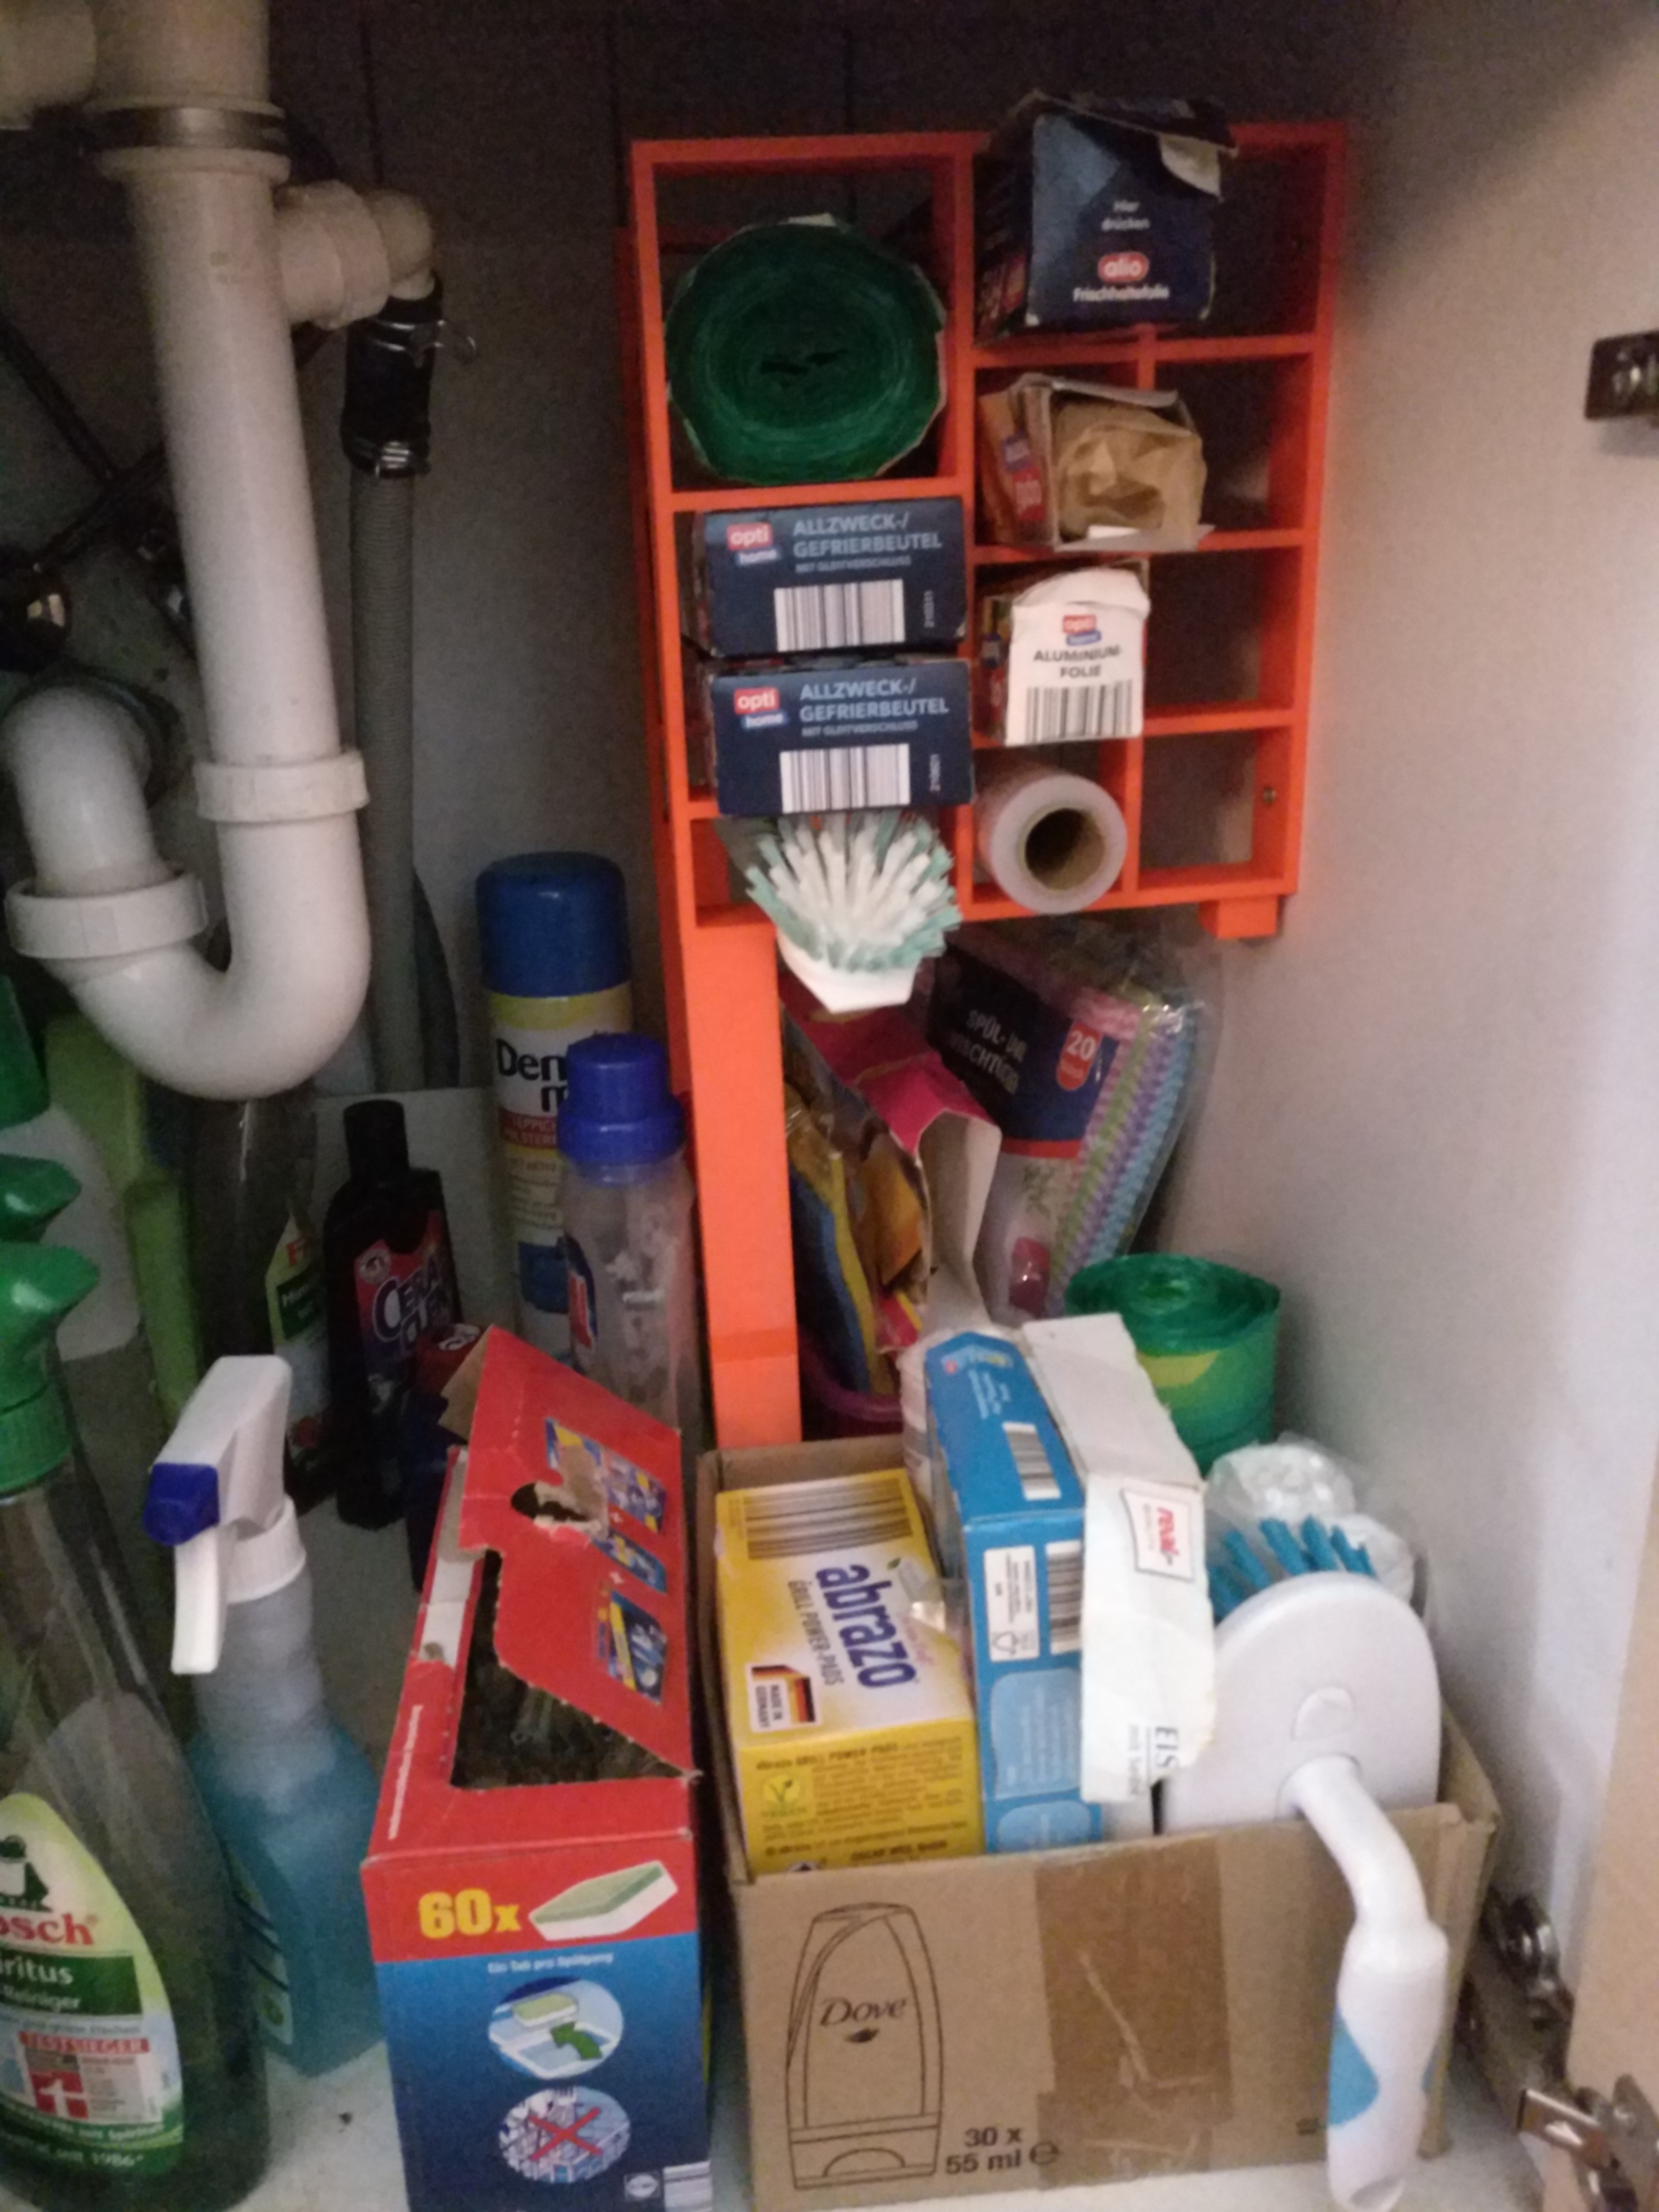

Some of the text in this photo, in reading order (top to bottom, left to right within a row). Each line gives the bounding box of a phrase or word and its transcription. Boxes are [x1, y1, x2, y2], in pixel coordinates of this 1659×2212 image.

[730, 525, 768, 547] opti
[793, 532, 942, 558] GEFRIERBEUTEL
[1060, 665, 1102, 678] FOLIE
[737, 689, 776, 711] opti
[799, 697, 950, 723] GEFRIERBEUTEL
[1067, 1030, 1096, 1062] 20
[816, 1564, 917, 1688] abrazo
[418, 1888, 522, 1939] 60x
[820, 1998, 906, 2027] Dove
[965, 2128, 1023, 2148] 30 x
[946, 2153, 978, 2175] 55
[987, 2149, 1022, 2172] ml
